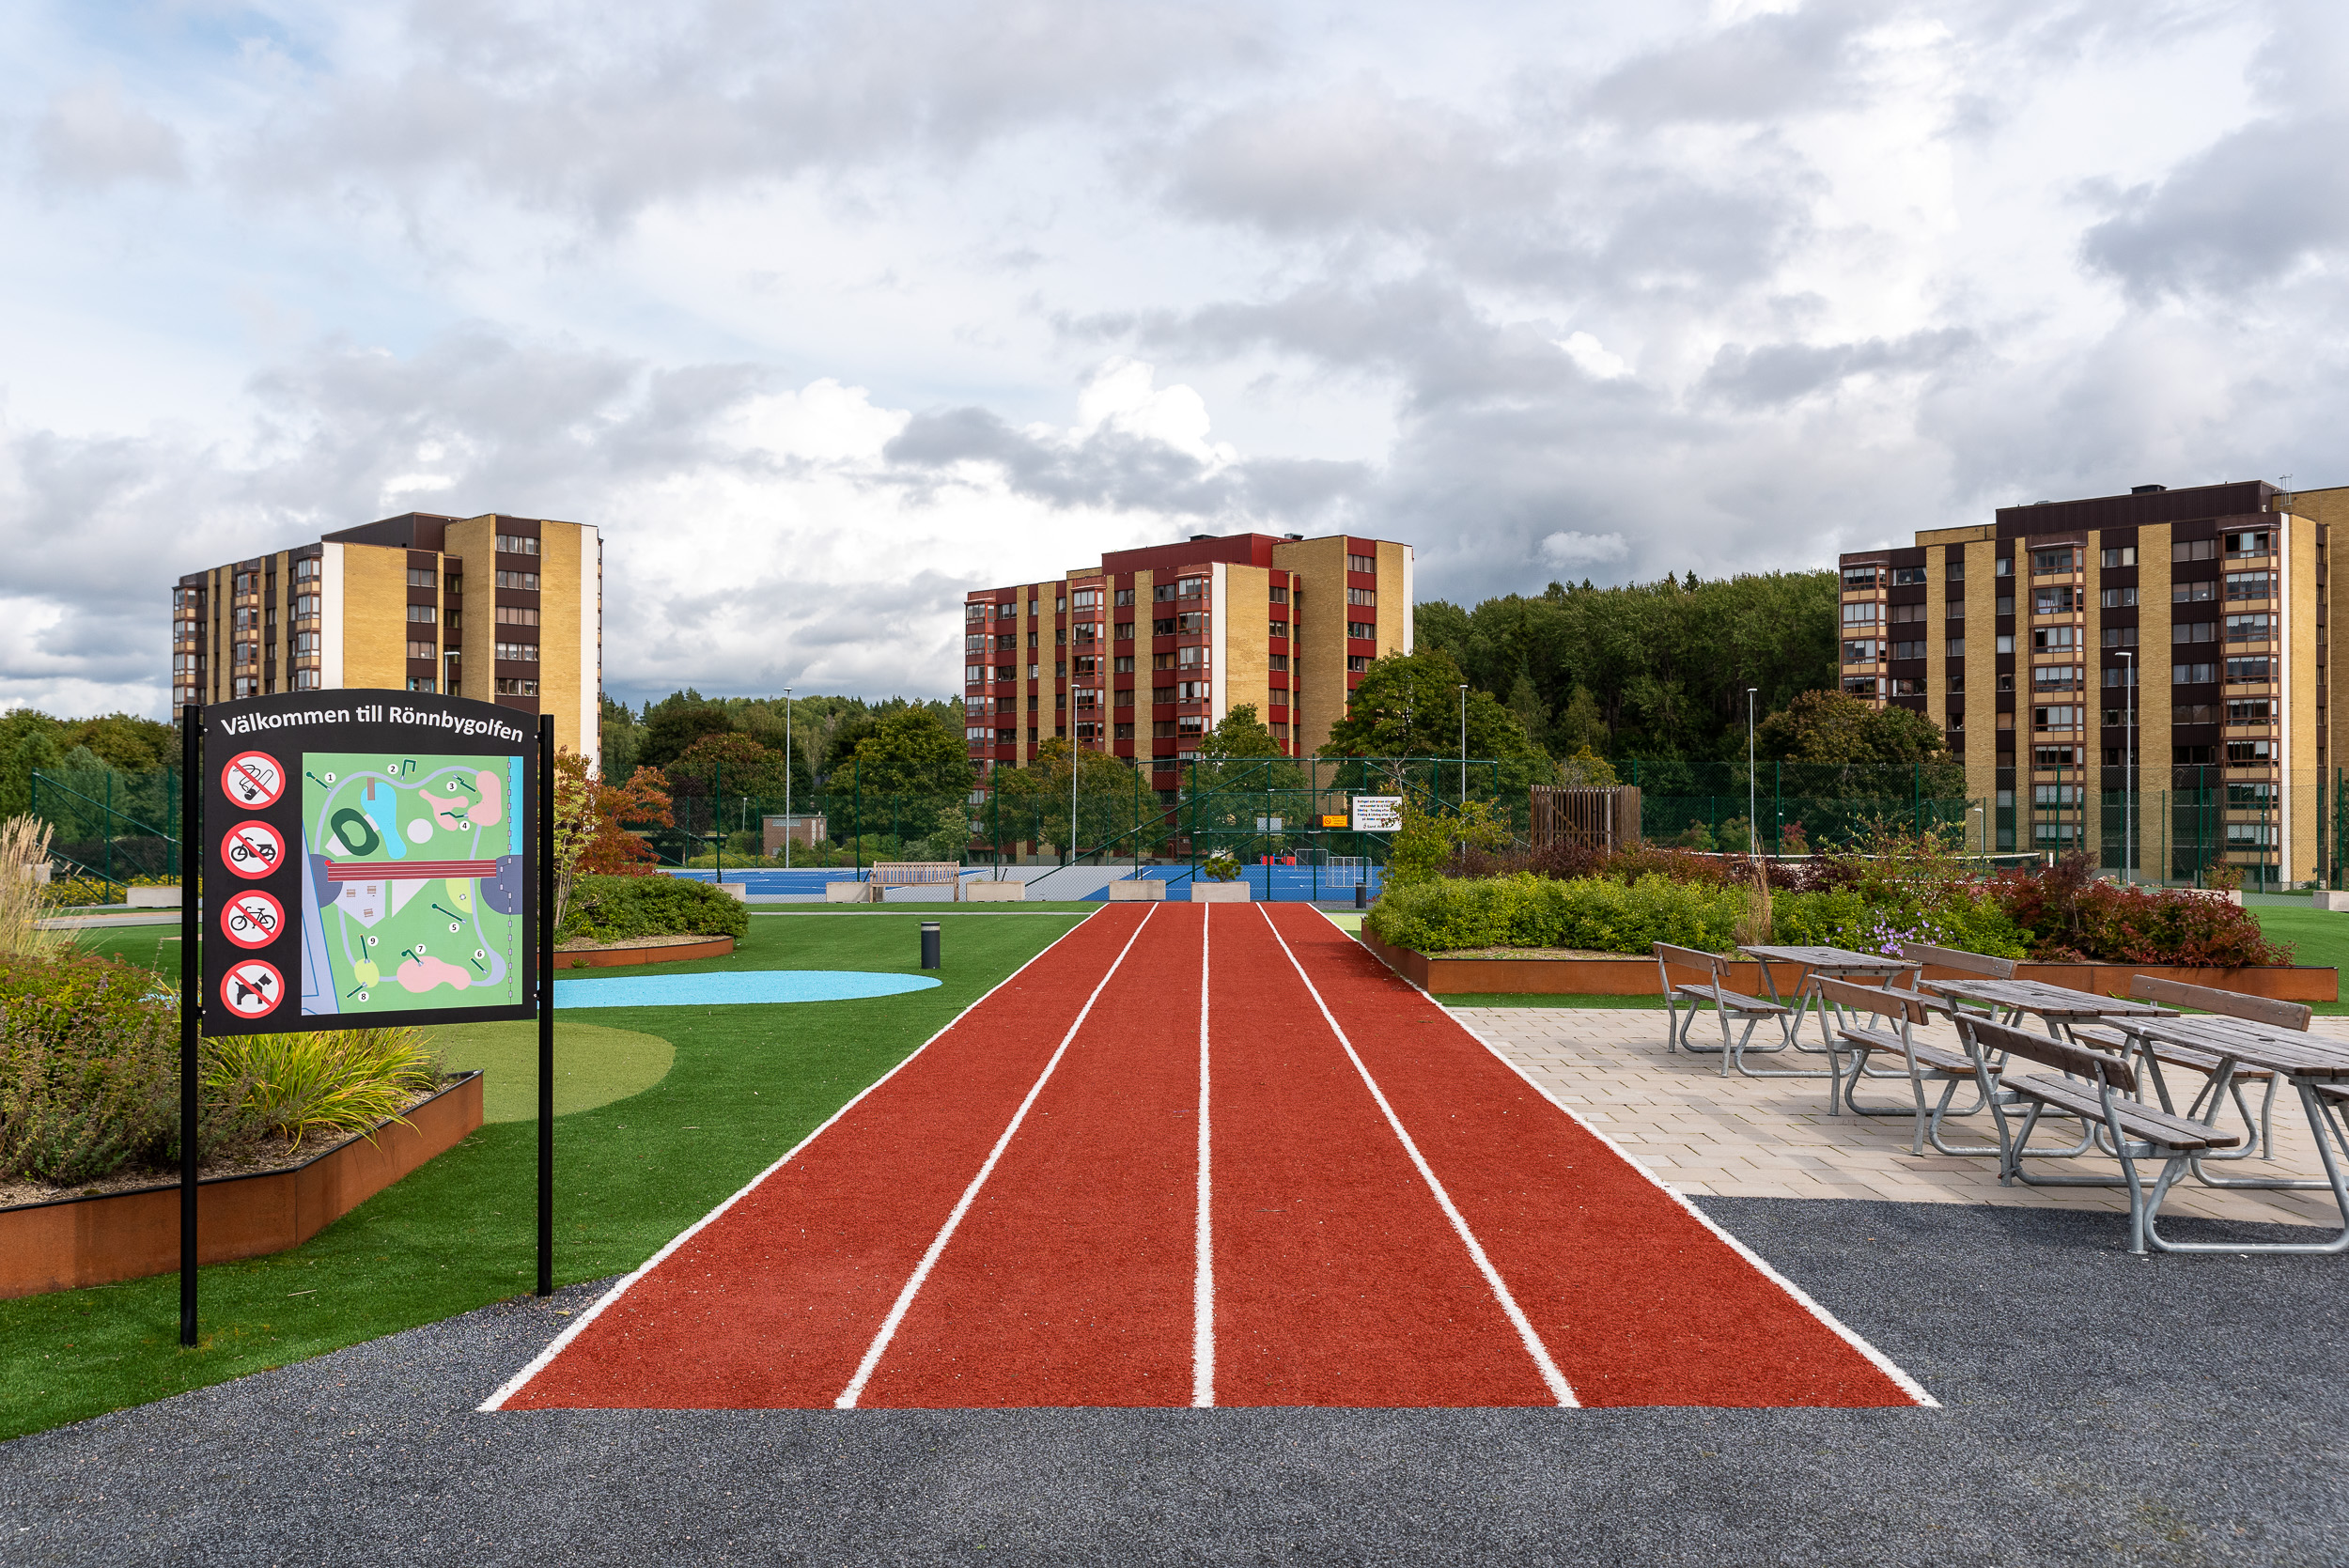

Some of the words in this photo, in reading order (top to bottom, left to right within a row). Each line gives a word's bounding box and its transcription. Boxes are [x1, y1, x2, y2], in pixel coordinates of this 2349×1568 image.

[220, 709, 350, 736] Välkommen
[355, 705, 382, 722] till
[389, 706, 523, 743] Rönnbygolfen
